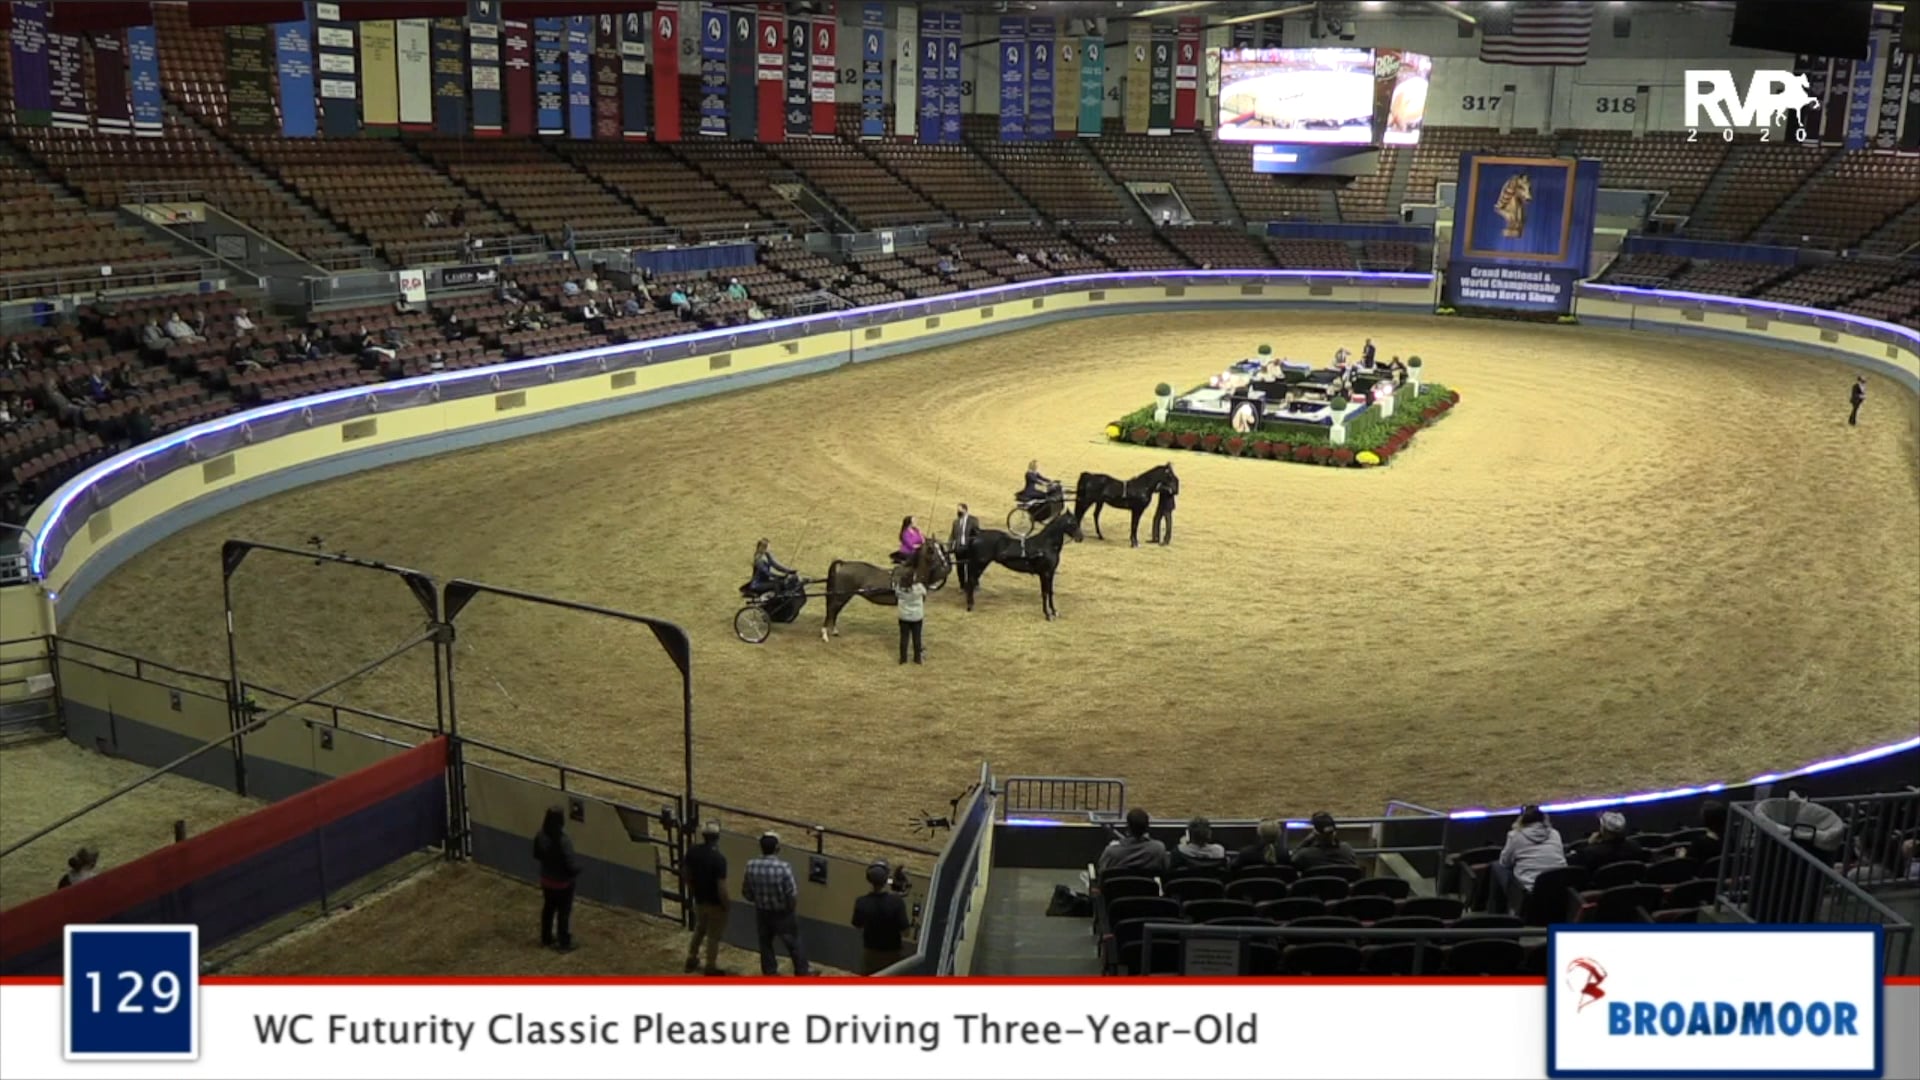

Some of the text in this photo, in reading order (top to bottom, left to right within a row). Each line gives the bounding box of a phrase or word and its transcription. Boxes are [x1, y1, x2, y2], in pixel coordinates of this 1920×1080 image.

[834, 68, 858, 85] 12
[1461, 95, 1502, 111] 317
[1595, 97, 1637, 114] 318
[1471, 267, 1500, 278] Grand
[1501, 268, 1543, 281] National
[1460, 276, 1561, 294] World Championship
[1461, 287, 1498, 299] Morgan
[1498, 290, 1527, 301] Horse
